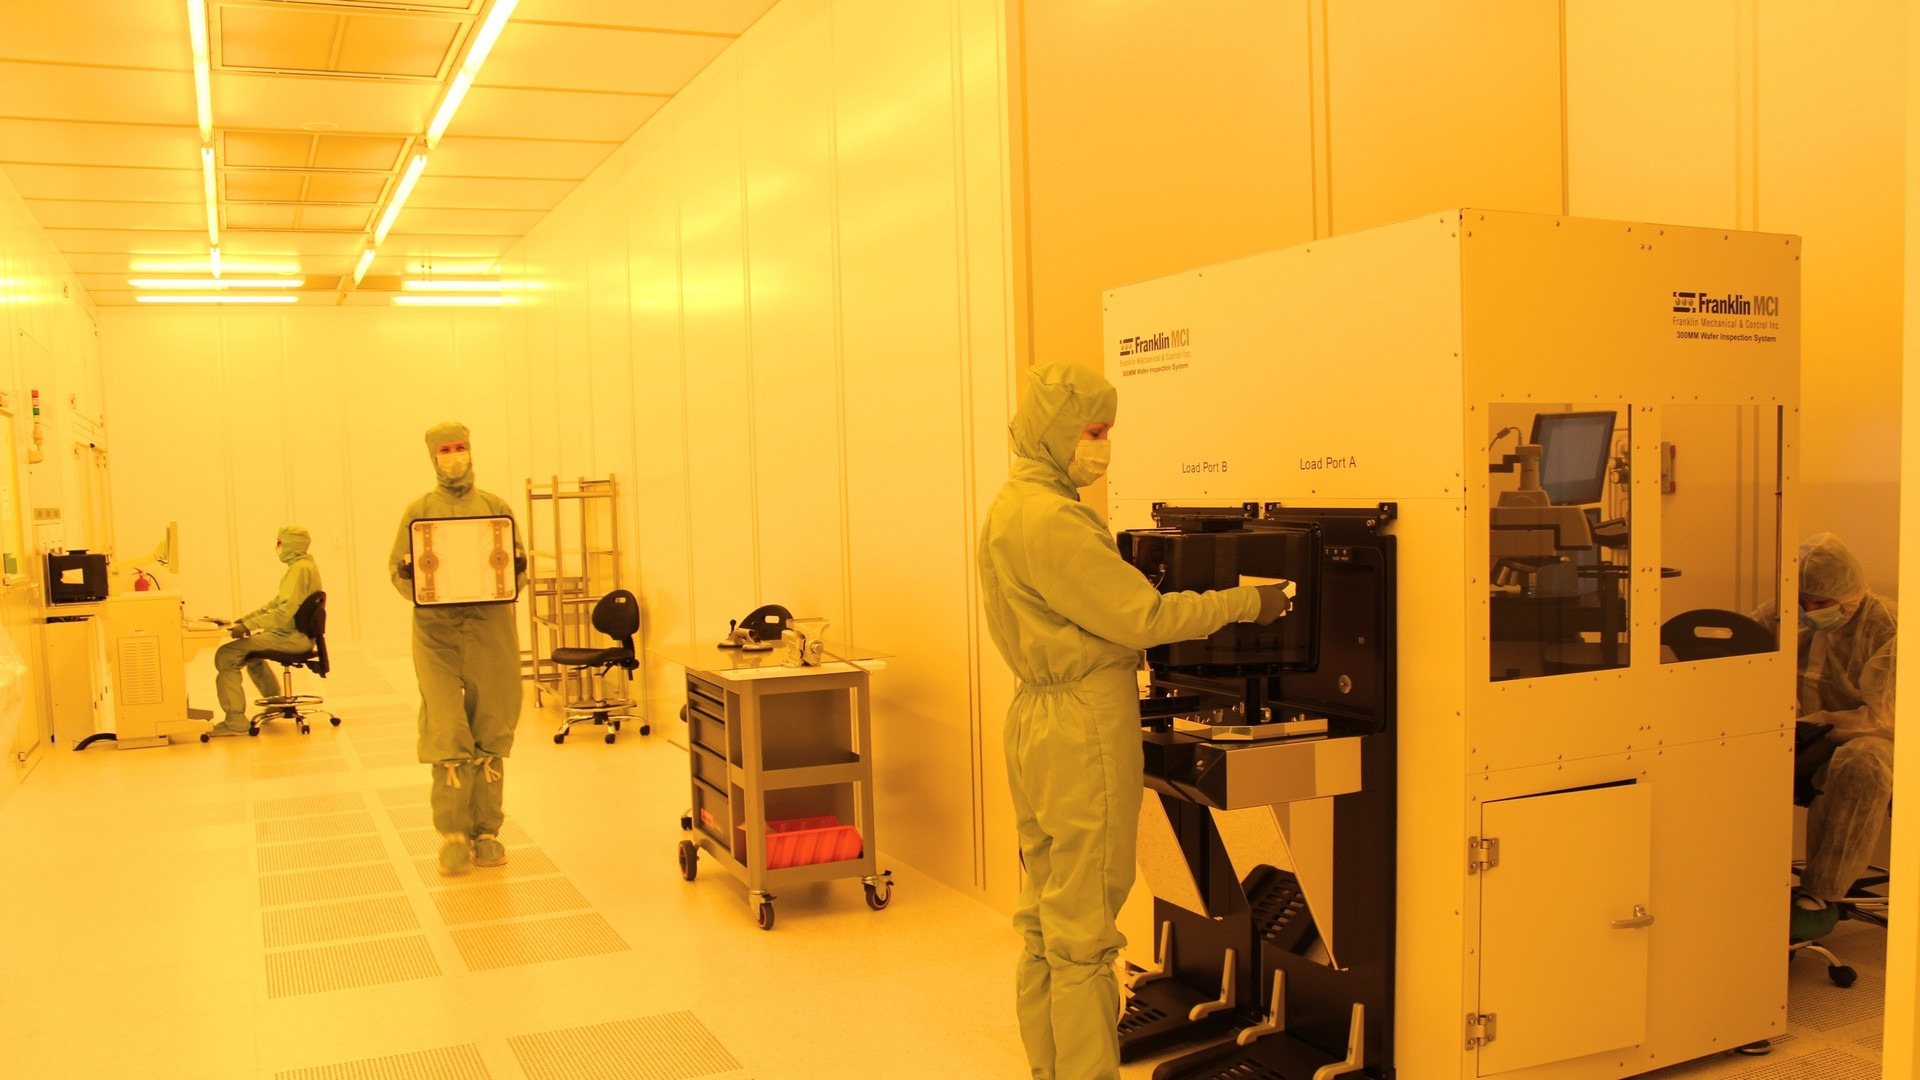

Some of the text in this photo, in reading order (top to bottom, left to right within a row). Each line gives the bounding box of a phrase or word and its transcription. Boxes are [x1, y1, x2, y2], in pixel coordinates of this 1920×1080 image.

[1699, 292, 1779, 317] Franklin MCI
[1672, 316, 1779, 330] Franklin Mechanical & Control Inc
[1135, 328, 1190, 353] Franklin MCI
[1676, 331, 1776, 343] 300MM Wafer Inspection System
[1137, 367, 1149, 375] Wafer
[1149, 365, 1171, 373] Inspection
[1172, 363, 1189, 371] System
[1182, 461, 1228, 474] Load Port B
[1300, 455, 1357, 470] Load Port A
